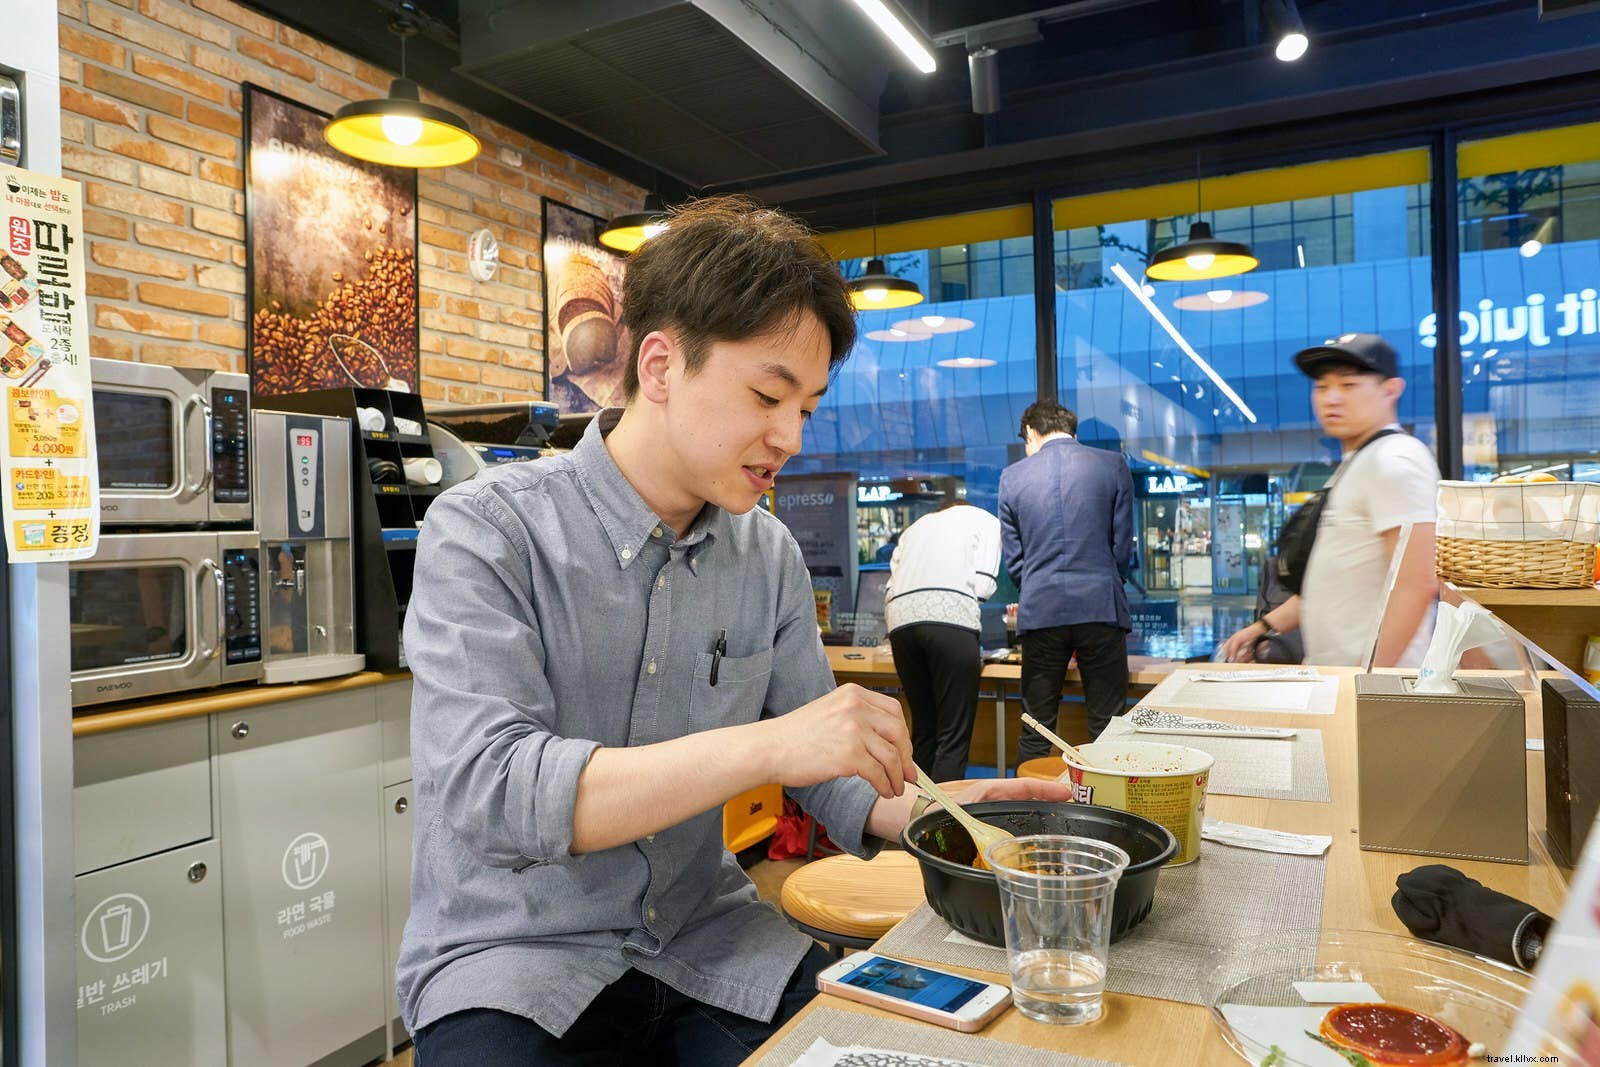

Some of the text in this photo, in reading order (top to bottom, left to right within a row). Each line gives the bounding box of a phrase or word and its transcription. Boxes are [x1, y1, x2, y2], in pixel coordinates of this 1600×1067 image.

[21, 185, 70, 203] 이제는 밥도
[10, 217, 30, 255] 원조
[32, 219, 75, 325] 따로밥
[42, 324, 72, 338] 도시락
[50, 337, 72, 353] 2종
[32, 443, 74, 455] 4,000원
[51, 523, 89, 544] 증정
[96, 681, 133, 693] DAEWOO
[278, 890, 335, 925] 라면 국물
[283, 924, 306, 939] FOOD
[112, 956, 168, 994] 쓰레기
[100, 994, 137, 1016] TRASH
